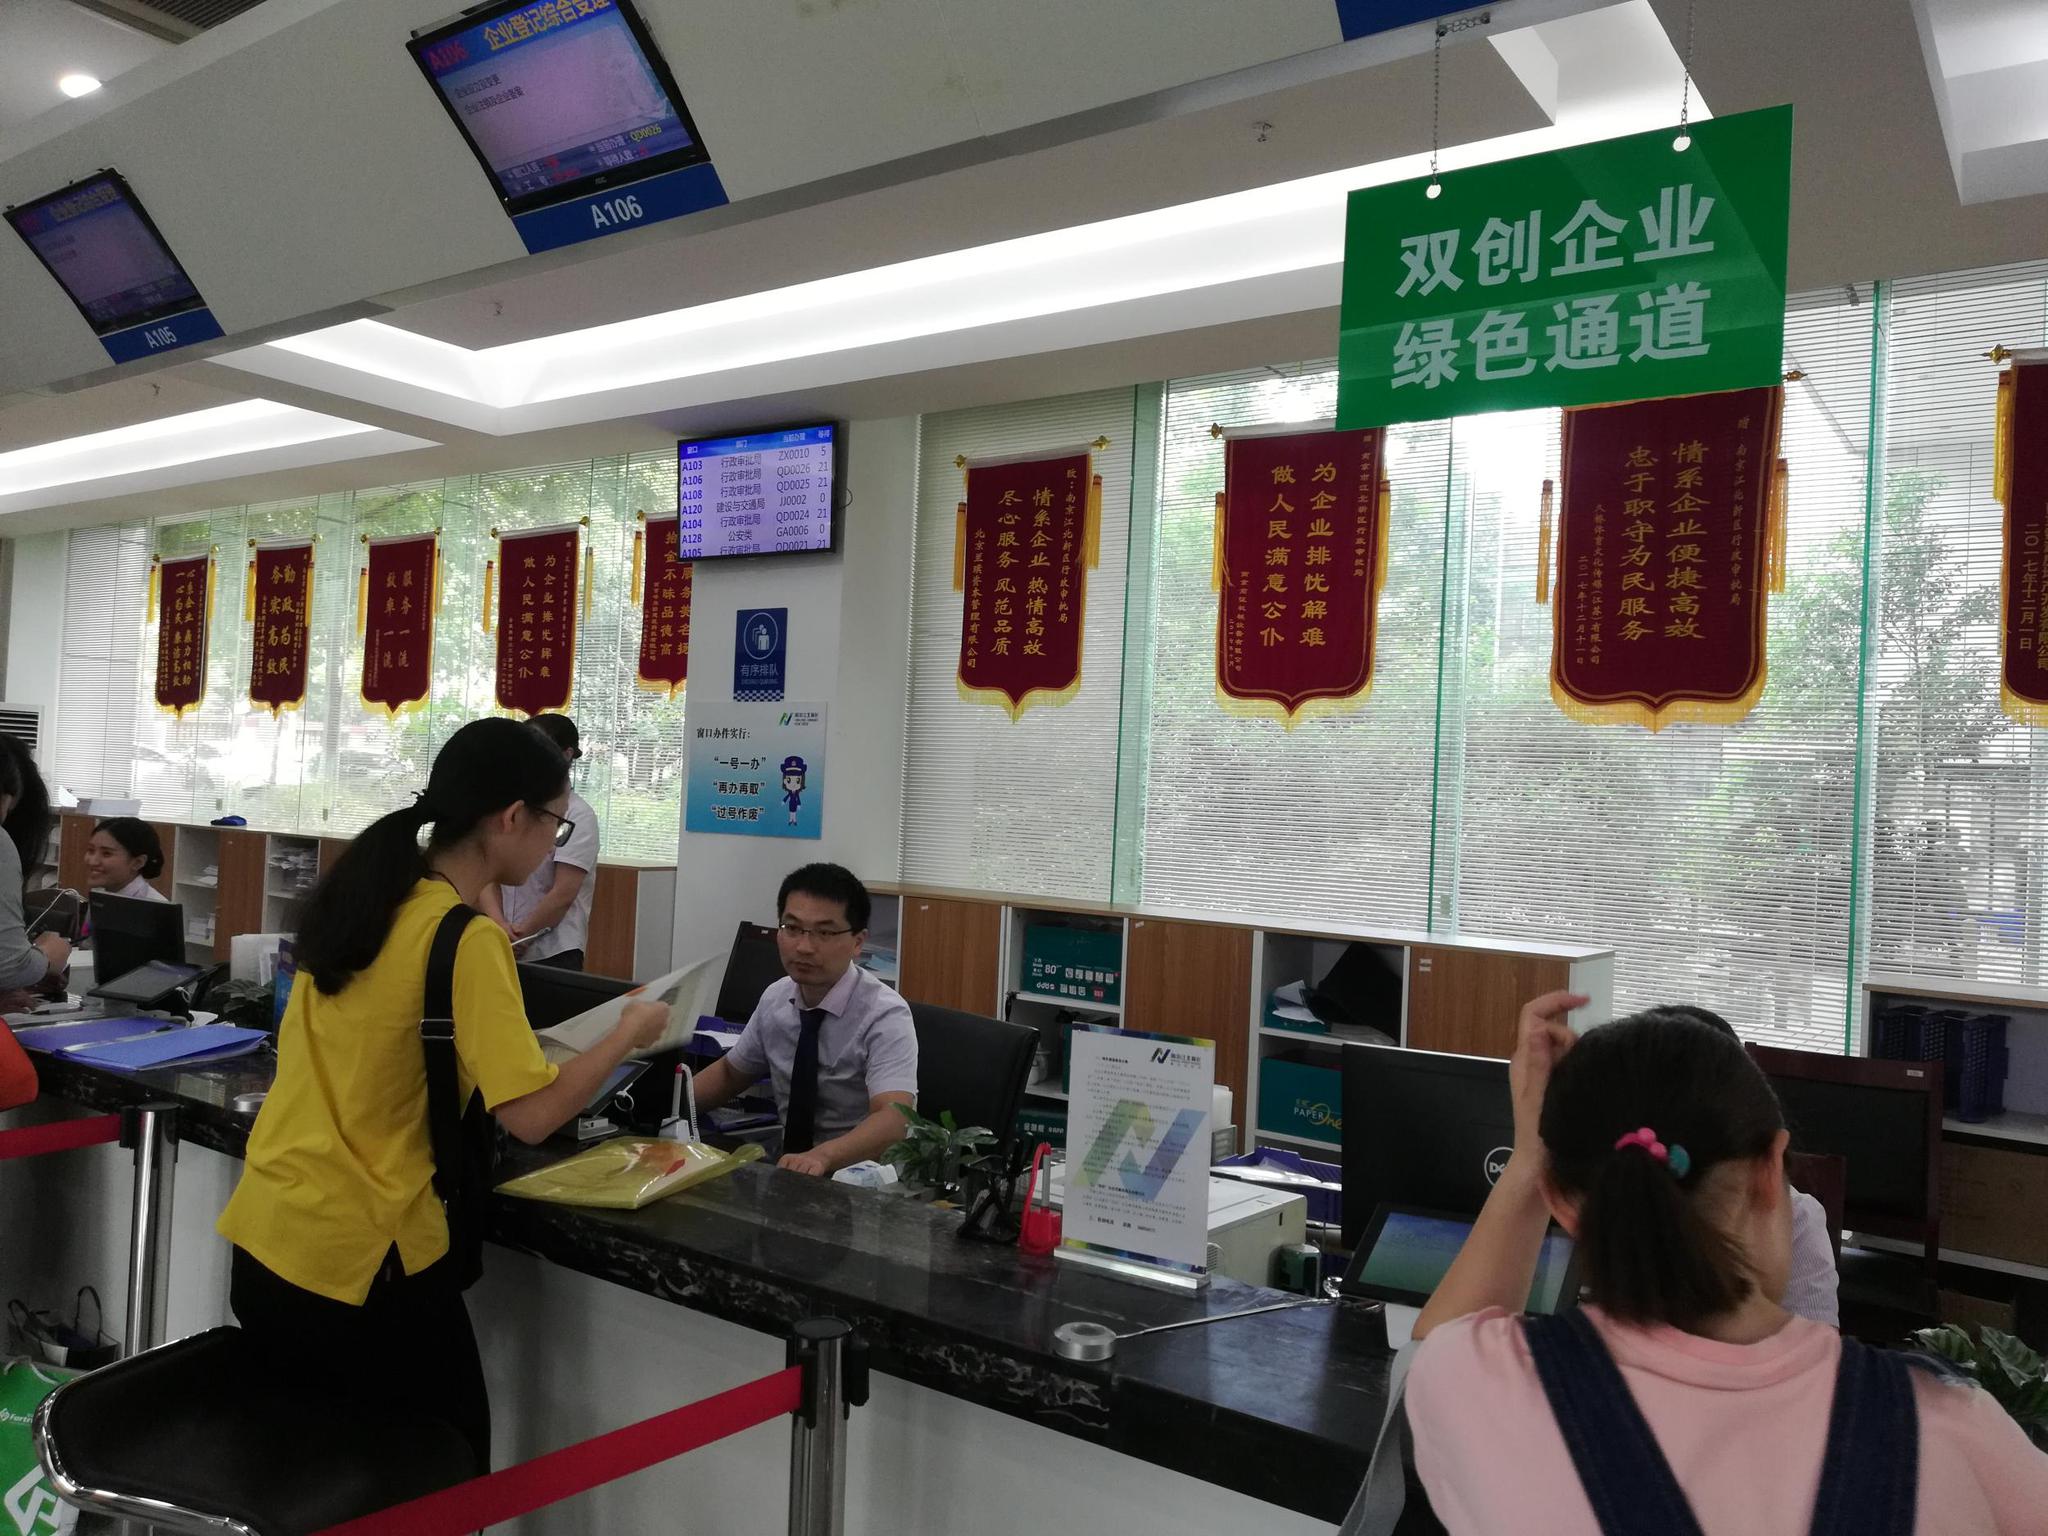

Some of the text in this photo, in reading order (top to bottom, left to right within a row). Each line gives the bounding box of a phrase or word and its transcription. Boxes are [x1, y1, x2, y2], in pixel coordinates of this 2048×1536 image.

[591, 194, 643, 229] A106
[1394, 183, 1716, 298] 双创企业
[144, 326, 178, 349] A105
[1390, 281, 1712, 391] 绿色通道
[682, 446, 826, 472] A103 行政审批局 ZX0010 5
[682, 461, 828, 486] A106 行政审批局 QD0026 21
[682, 477, 828, 500] A108 行政审批局 QD0025 21
[682, 492, 825, 515] A120 建设与交通局 JJ0002 0
[682, 508, 827, 530] A104 行政审批局 QD0024 21
[682, 524, 825, 544] A128 公安类 GA0006 0
[1616, 445, 1658, 641] 忠于职守为民服务
[1663, 440, 1712, 640] 情系企业便捷高效
[1259, 465, 1297, 648] 做人民满意公仆
[1299, 462, 1338, 648] 为企业排忧解难
[990, 489, 1024, 656] 尽心服务风范品质
[740, 663, 779, 678] 有序排队
[696, 727, 751, 740] 窗口办件实行：
[714, 756, 767, 770] “一号一办”
[712, 781, 765, 795] “再办再取”
[711, 806, 764, 821] “过号作废”
[1045, 964, 1057, 974] 80
